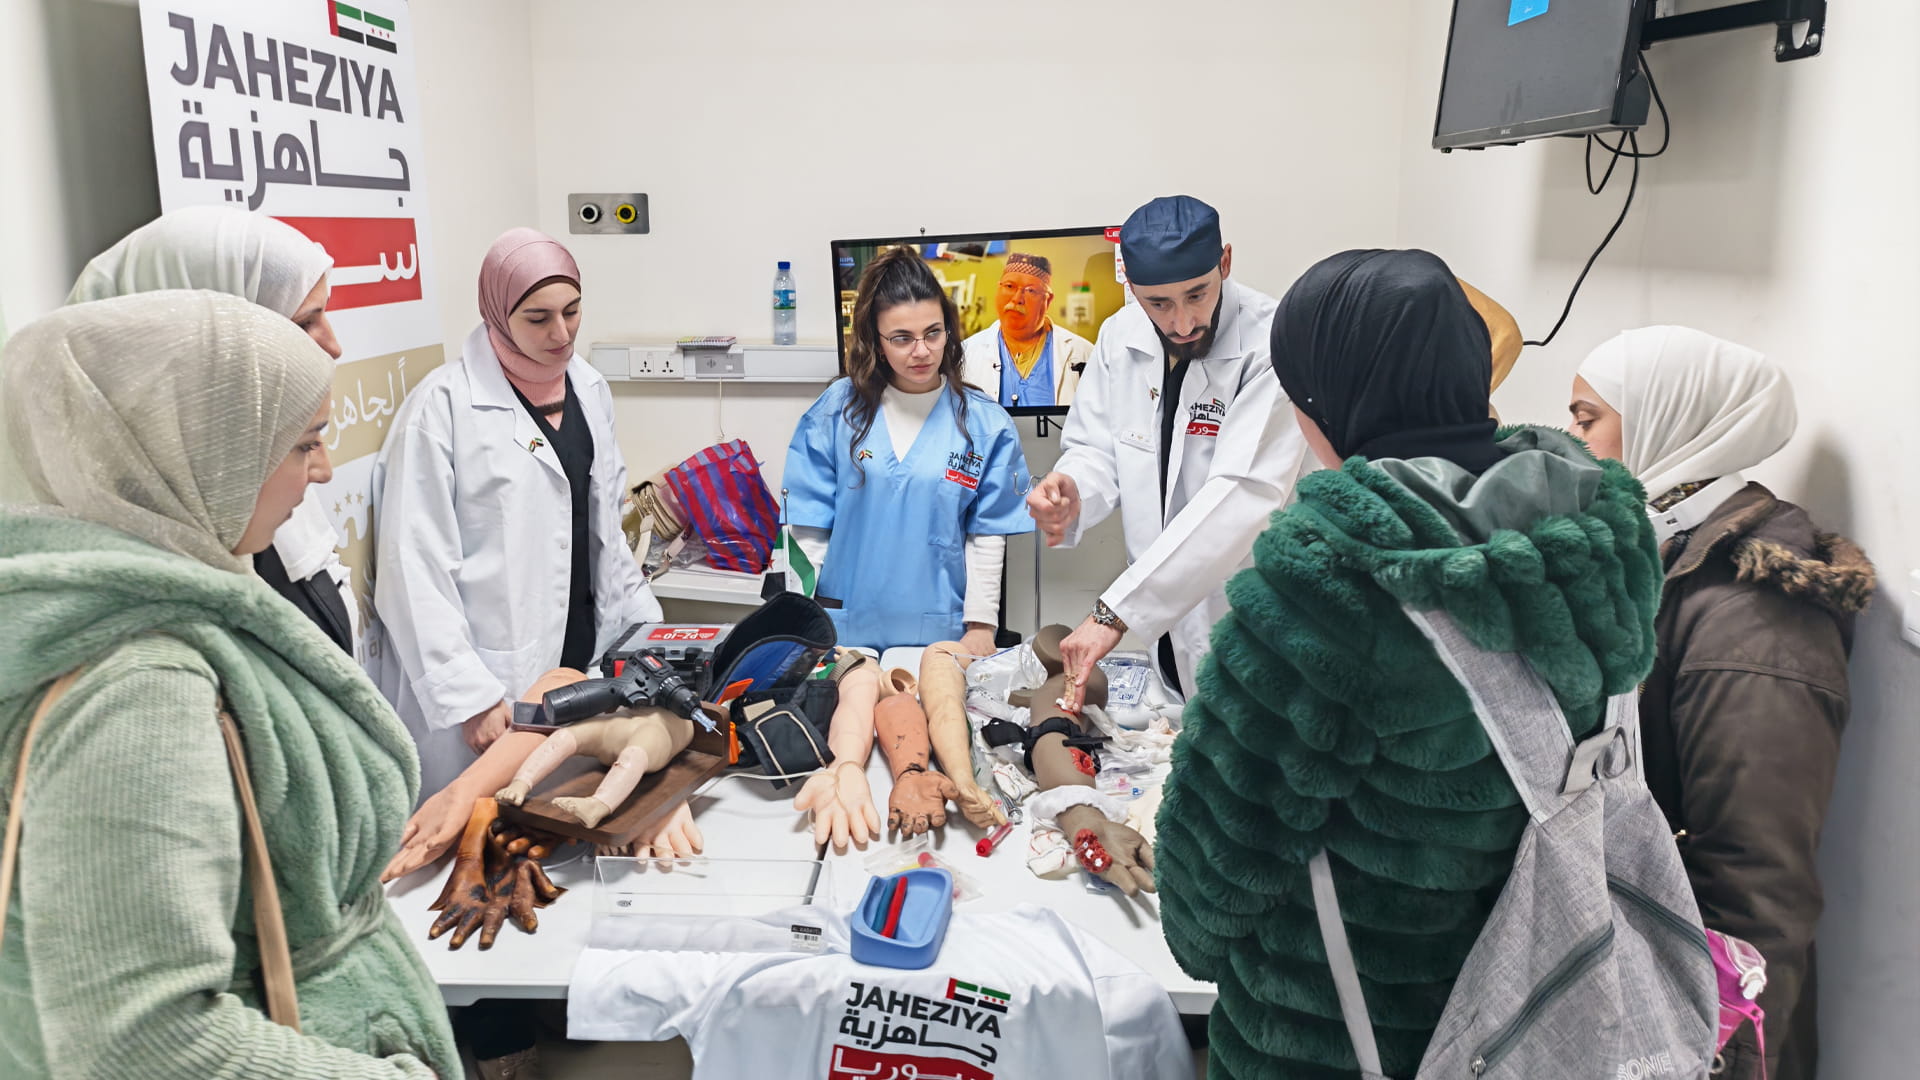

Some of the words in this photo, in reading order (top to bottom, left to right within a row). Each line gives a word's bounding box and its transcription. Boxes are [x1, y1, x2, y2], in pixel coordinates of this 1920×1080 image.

[168, 11, 404, 123] JAHEZIYA
[178, 99, 411, 211] جاهزية
[839, 1009, 998, 1067] جاهزية
[846, 982, 1001, 1038] JAHEZIYA
